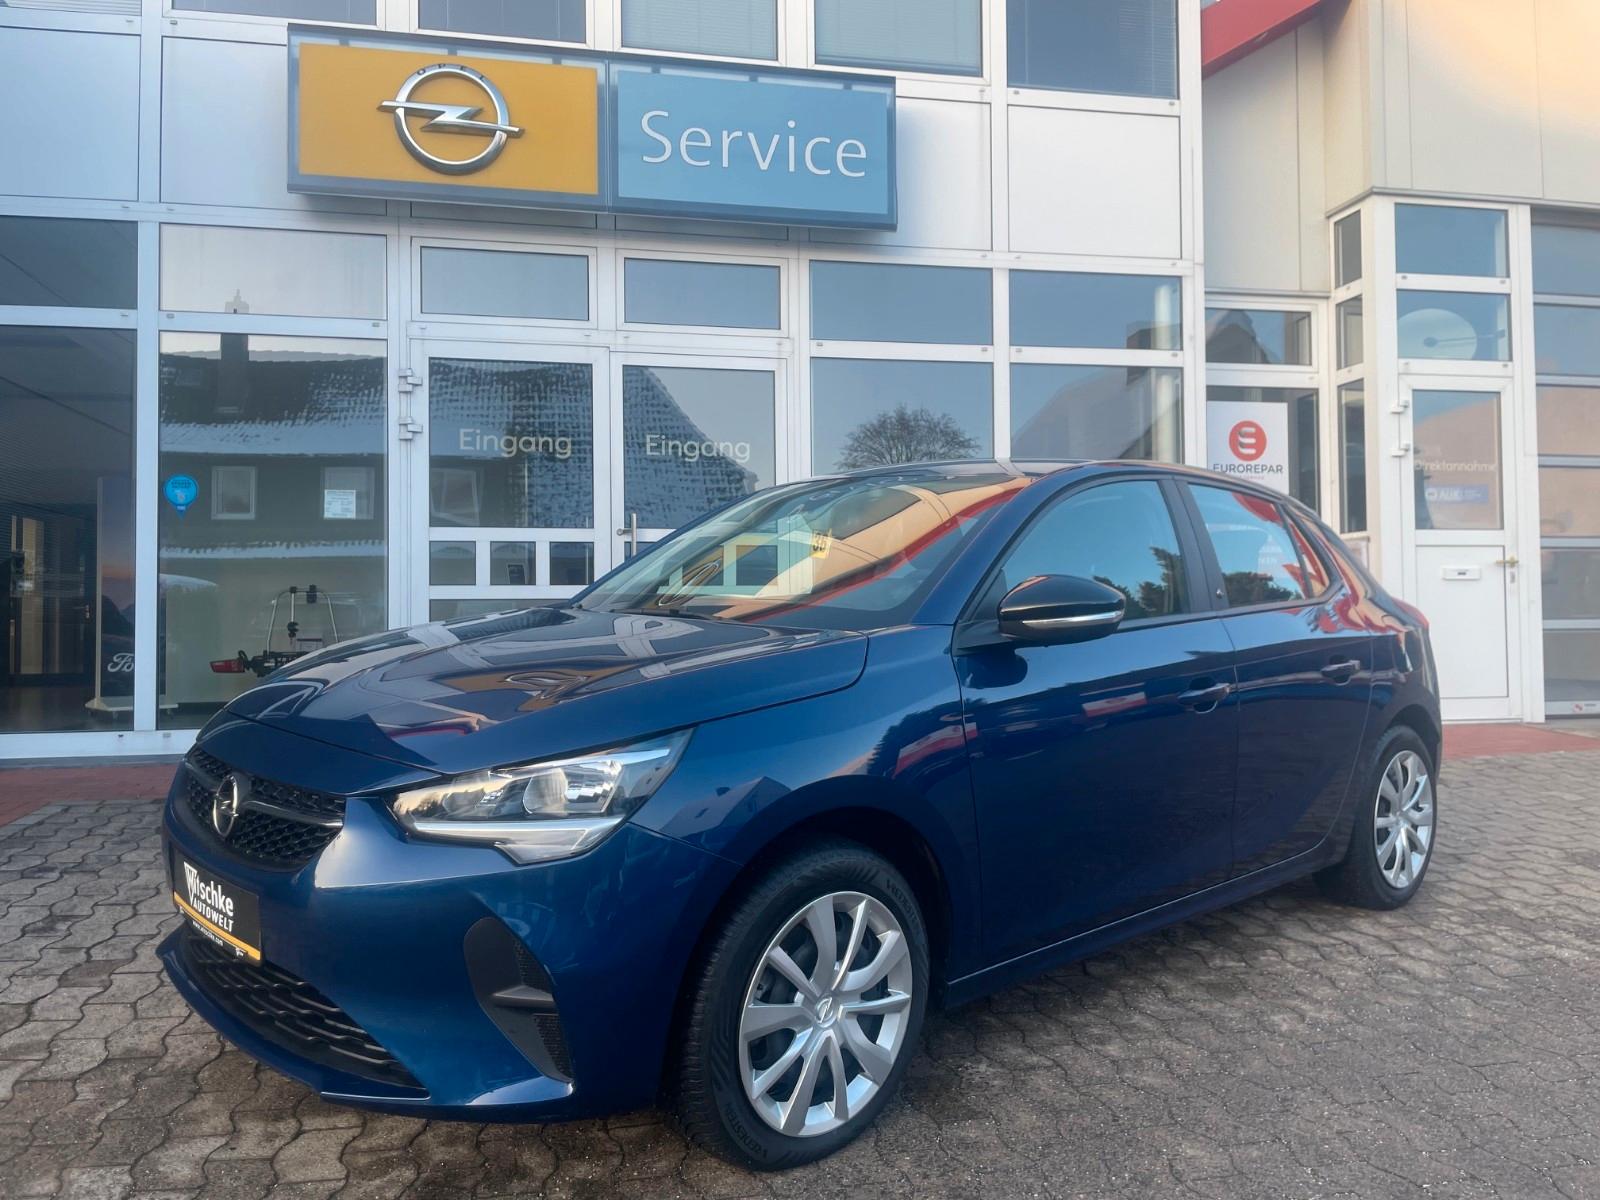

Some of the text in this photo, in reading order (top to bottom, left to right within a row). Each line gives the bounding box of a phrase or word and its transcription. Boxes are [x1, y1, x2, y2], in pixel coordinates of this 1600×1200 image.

[641, 110, 867, 177] Service
[459, 428, 572, 460] Eingang
[645, 434, 751, 462] Eingang
[1212, 463, 1284, 474] EUROREPAR
[107, 652, 135, 673] Fo
[192, 897, 234, 932] AUTOWELT
